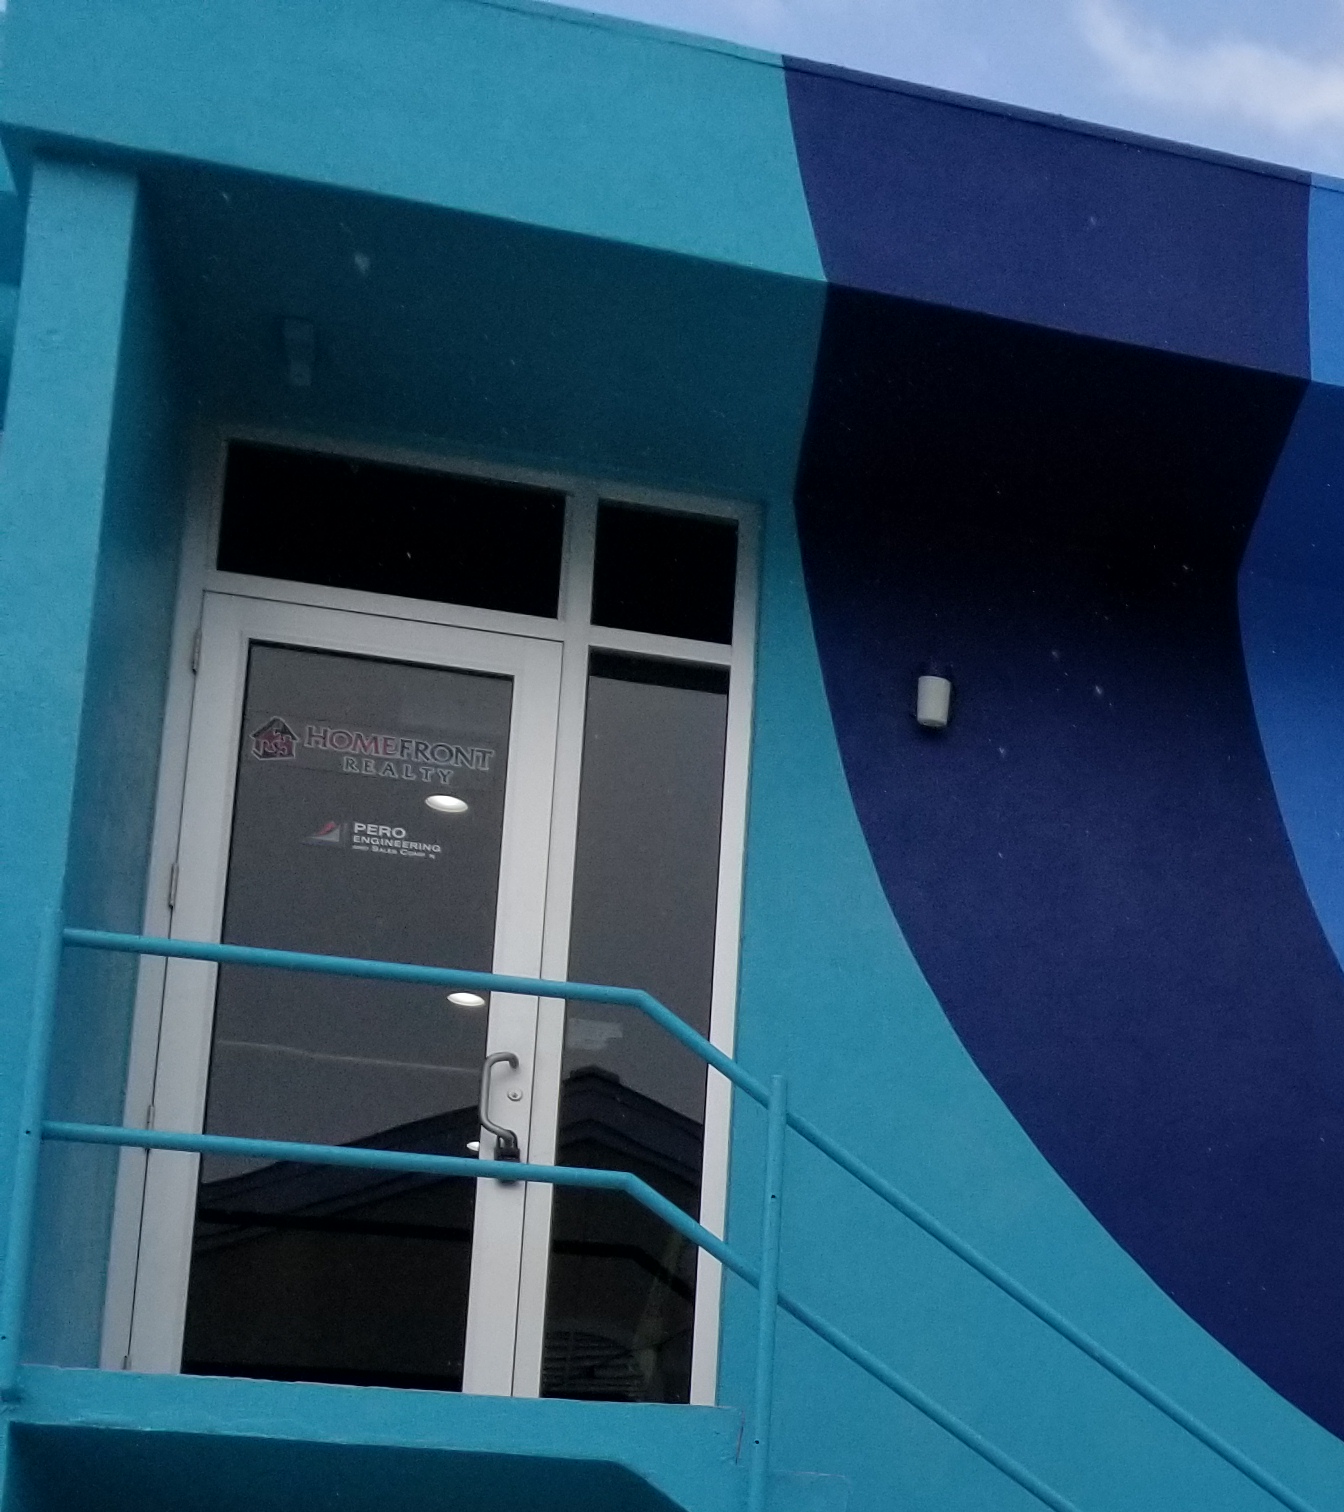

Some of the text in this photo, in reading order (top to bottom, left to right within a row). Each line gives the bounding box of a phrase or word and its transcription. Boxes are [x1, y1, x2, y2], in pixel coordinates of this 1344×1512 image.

[304, 725, 494, 771] HOMEFRONT
[343, 756, 454, 784] REALTY
[354, 822, 406, 839] PERO
[353, 835, 441, 853] ENGINEERING
